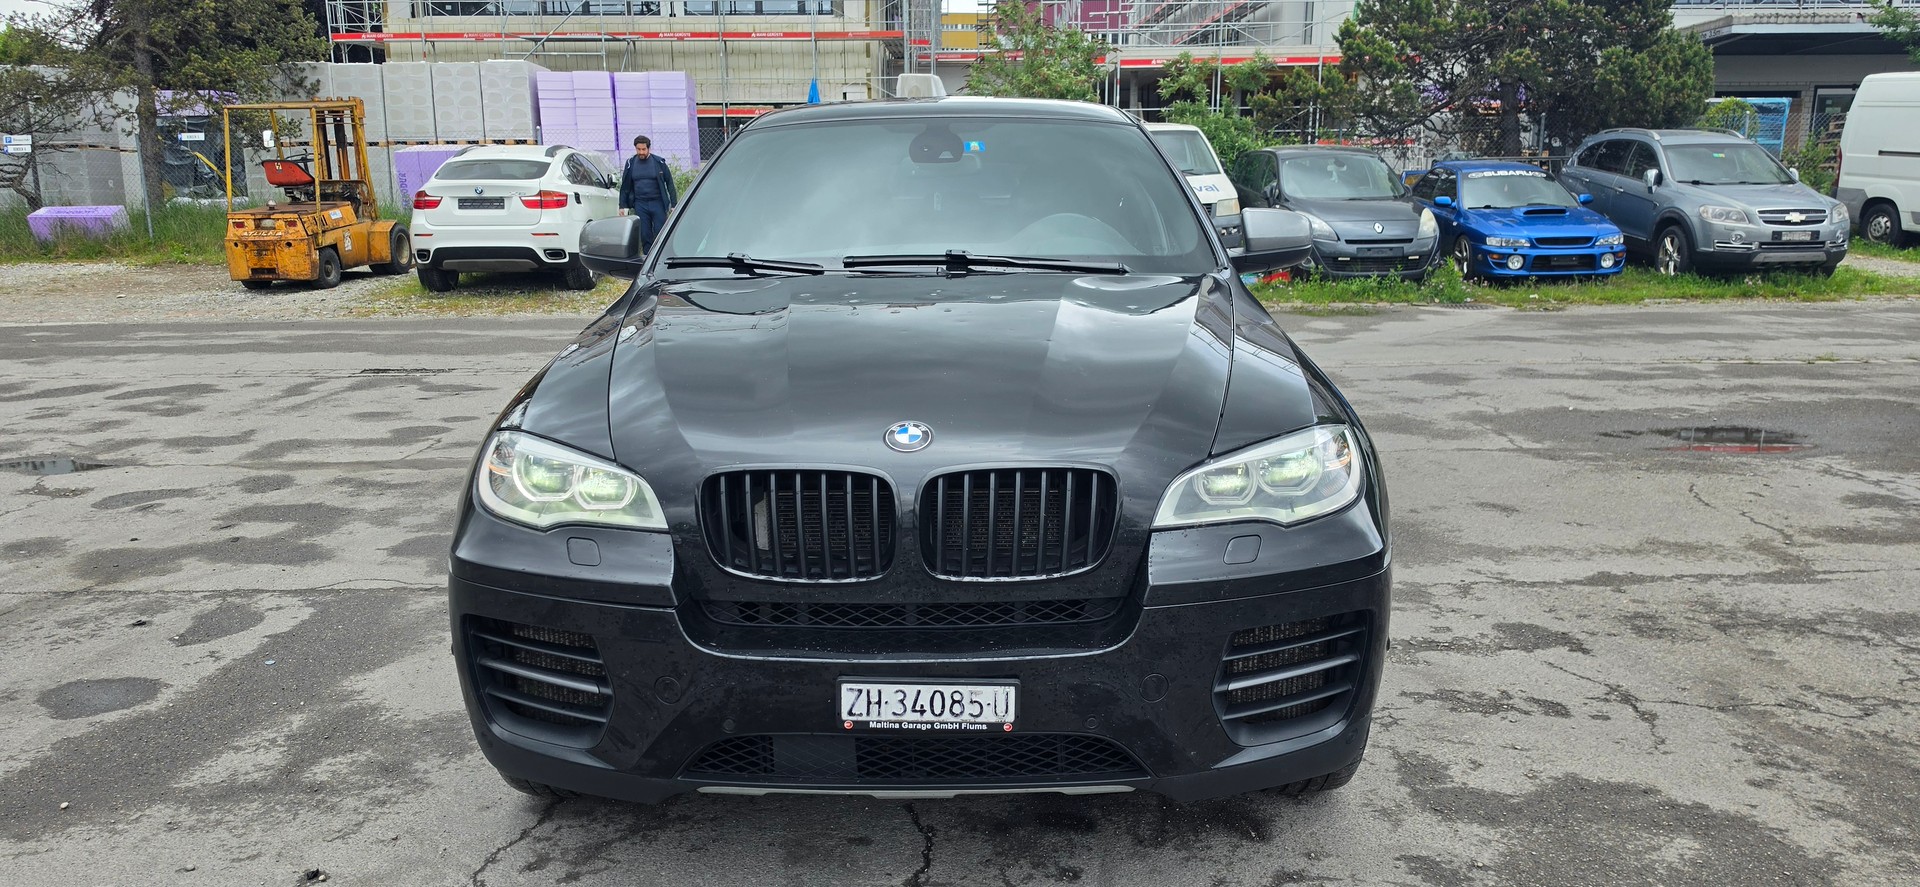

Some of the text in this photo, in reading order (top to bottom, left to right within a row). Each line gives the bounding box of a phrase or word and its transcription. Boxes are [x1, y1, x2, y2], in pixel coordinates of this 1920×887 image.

[1193, 183, 1220, 192] val
[869, 721, 988, 731] Maltina Garage GmbH Flums
